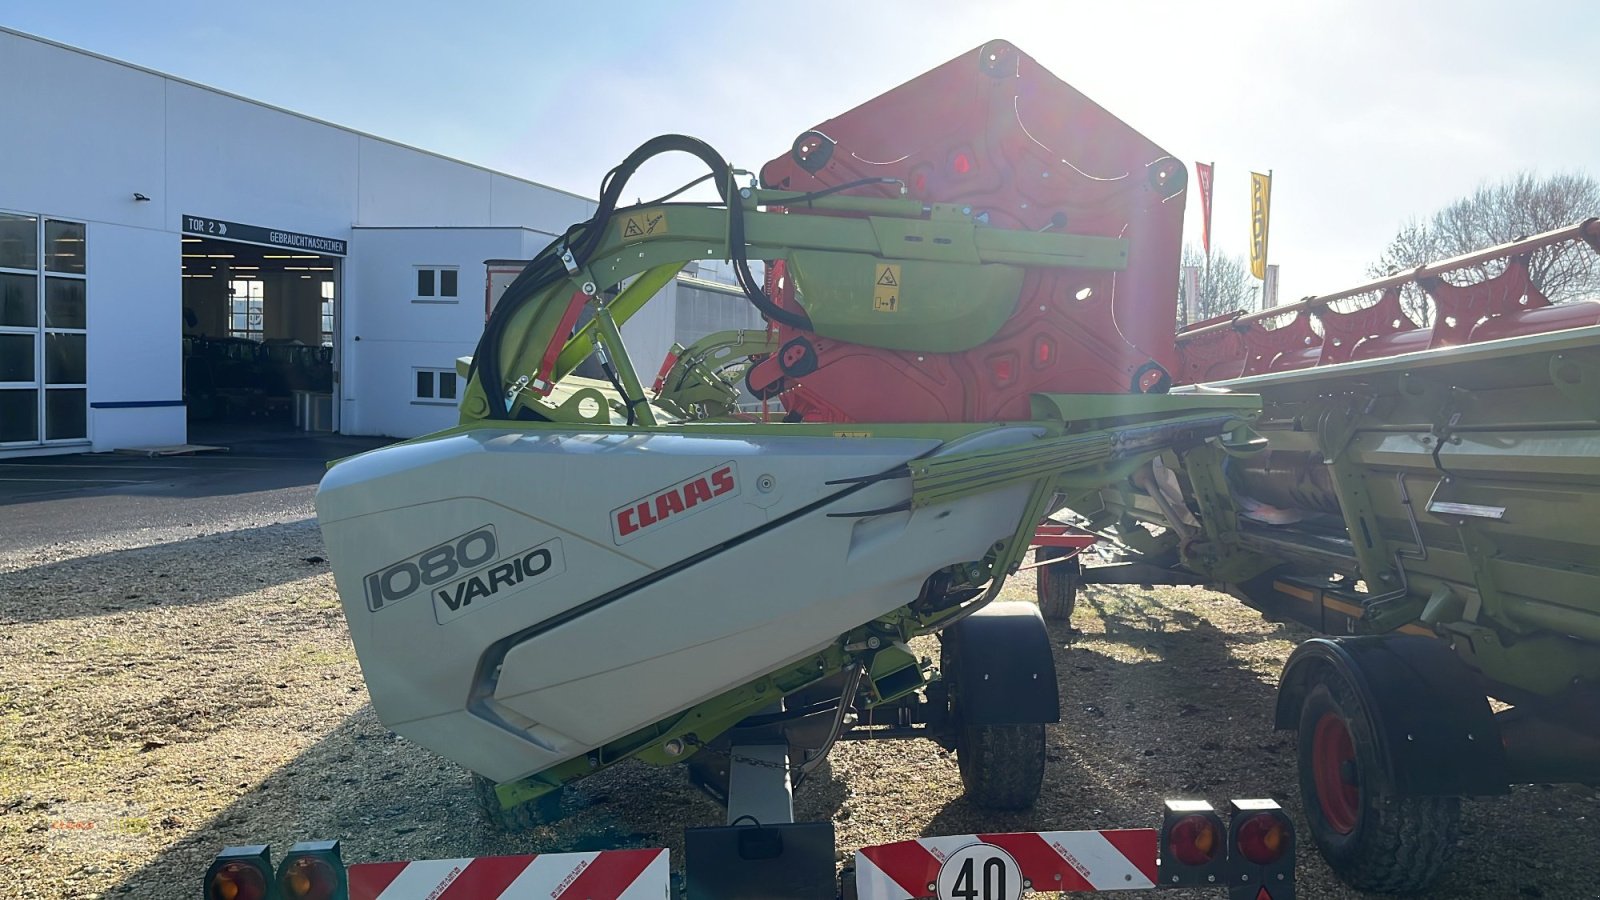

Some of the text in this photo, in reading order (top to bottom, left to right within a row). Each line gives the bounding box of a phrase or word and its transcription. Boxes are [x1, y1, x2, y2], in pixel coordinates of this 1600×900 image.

[188, 217, 215, 233] TOR 2
[269, 231, 344, 252] GEBRAUCHTMASCHINEN
[617, 466, 734, 537] CLAAS
[368, 530, 496, 608] 1080
[438, 548, 552, 612] VARIO
[951, 857, 1006, 900] 40
